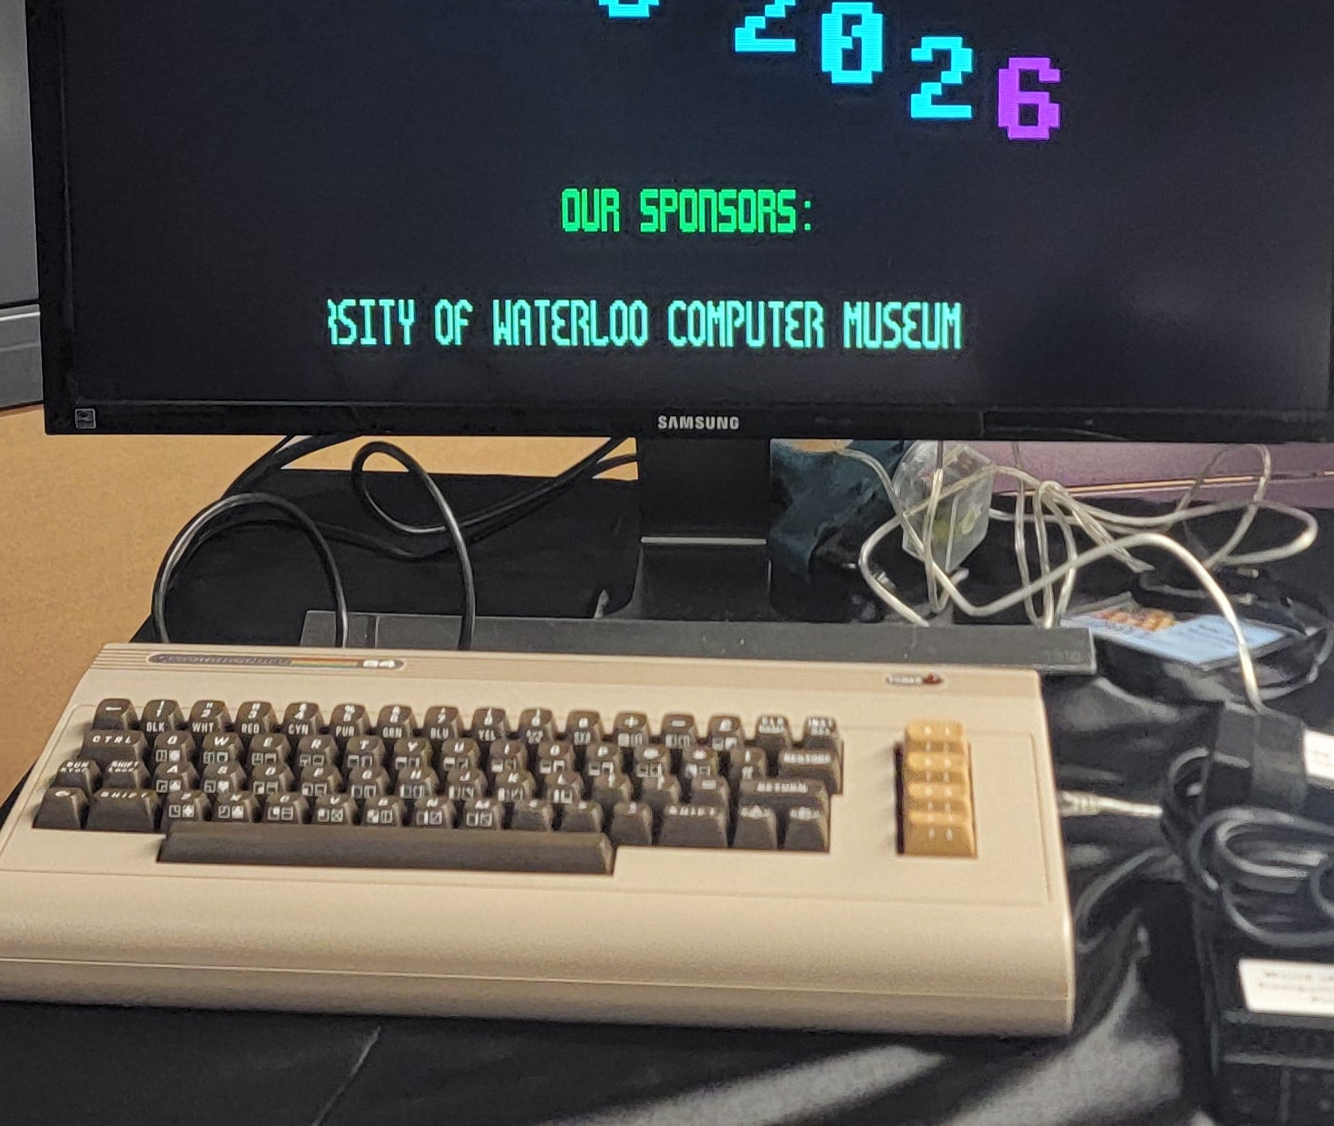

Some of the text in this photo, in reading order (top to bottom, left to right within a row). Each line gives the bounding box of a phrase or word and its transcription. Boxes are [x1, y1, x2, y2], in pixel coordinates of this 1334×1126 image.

[561, 188, 812, 233] OUR SPONSORS:
[434, 298, 474, 346] OF
[492, 298, 649, 347] WATERLOO
[668, 299, 825, 348] COMPUTER
[843, 300, 963, 349] MUSEUM
[657, 415, 740, 430] SAMSUNG
[192, 721, 215, 733] WHT
[91, 735, 133, 745] CTRL
[478, 728, 496, 741] YEL
